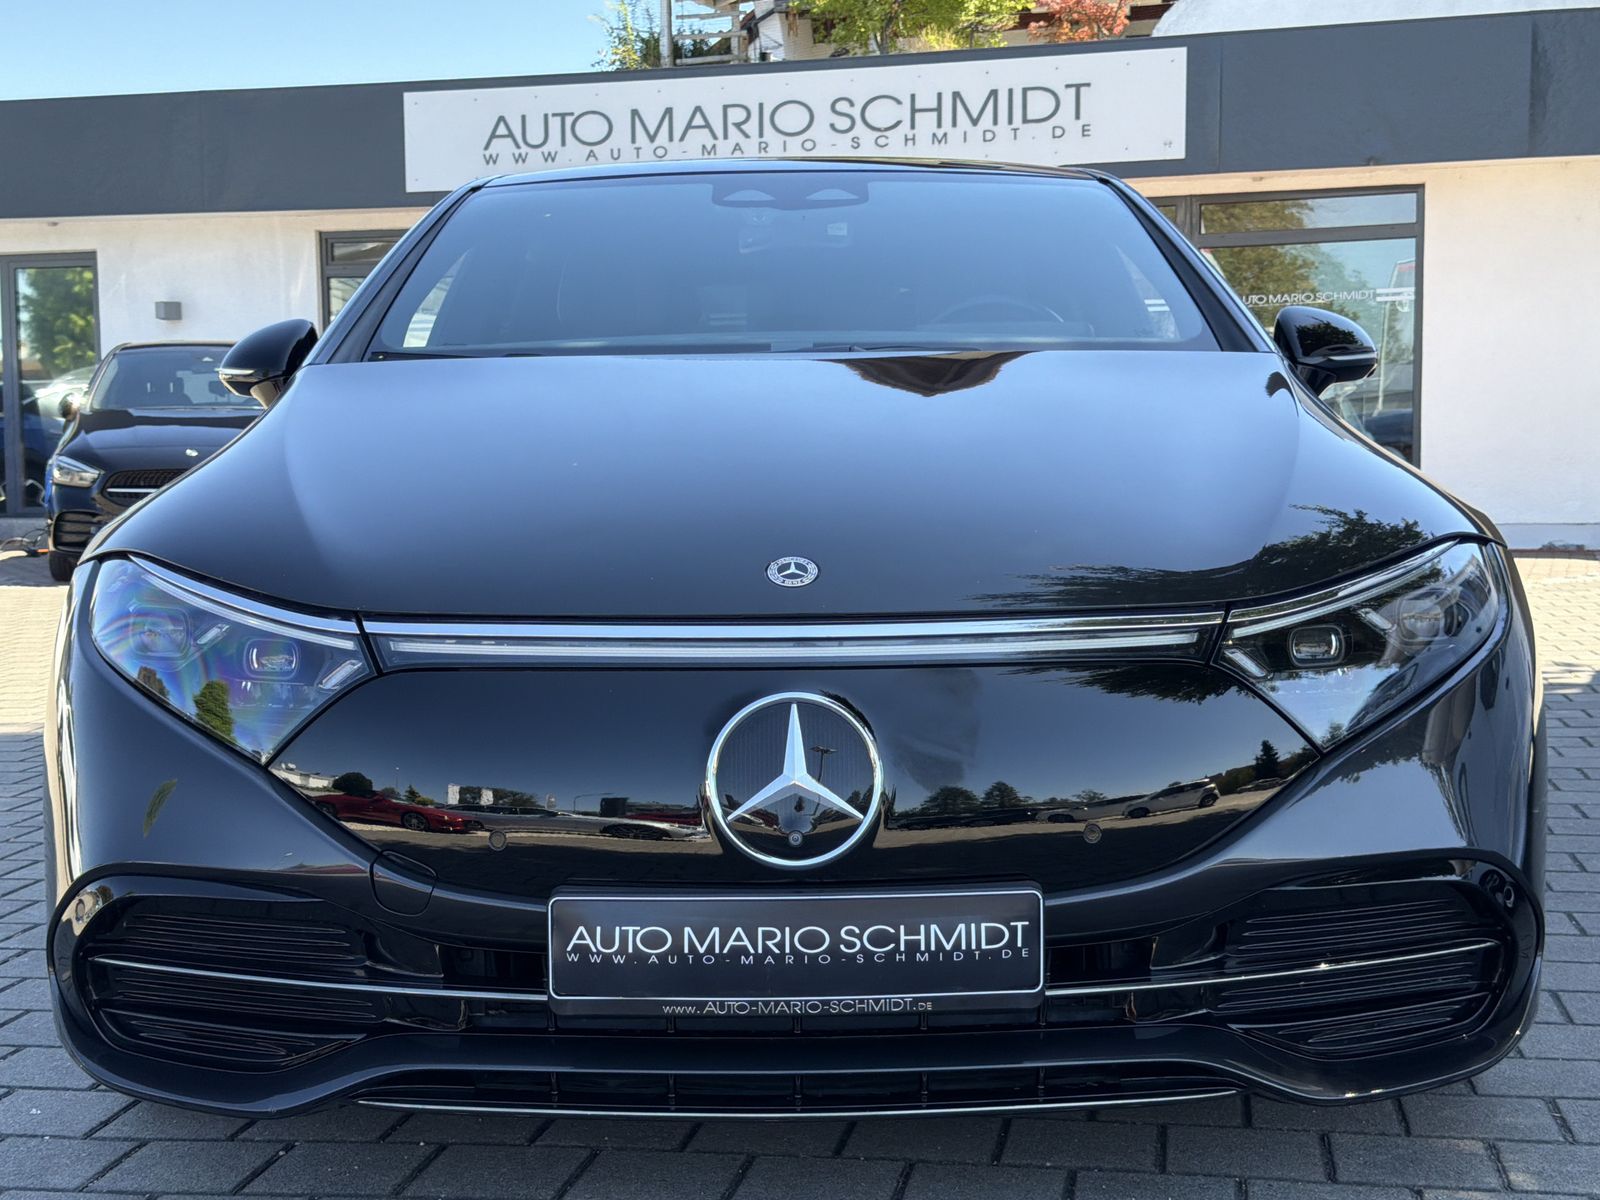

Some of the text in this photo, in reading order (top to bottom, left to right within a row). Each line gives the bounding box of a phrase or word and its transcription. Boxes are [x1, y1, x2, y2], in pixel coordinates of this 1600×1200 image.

[483, 82, 1092, 151] AUTO MARIO SCHMIDT
[1242, 289, 1376, 305] UTO MARIO SCHMIDT
[566, 921, 1030, 954] AUTO MARIO SCHMIDT
